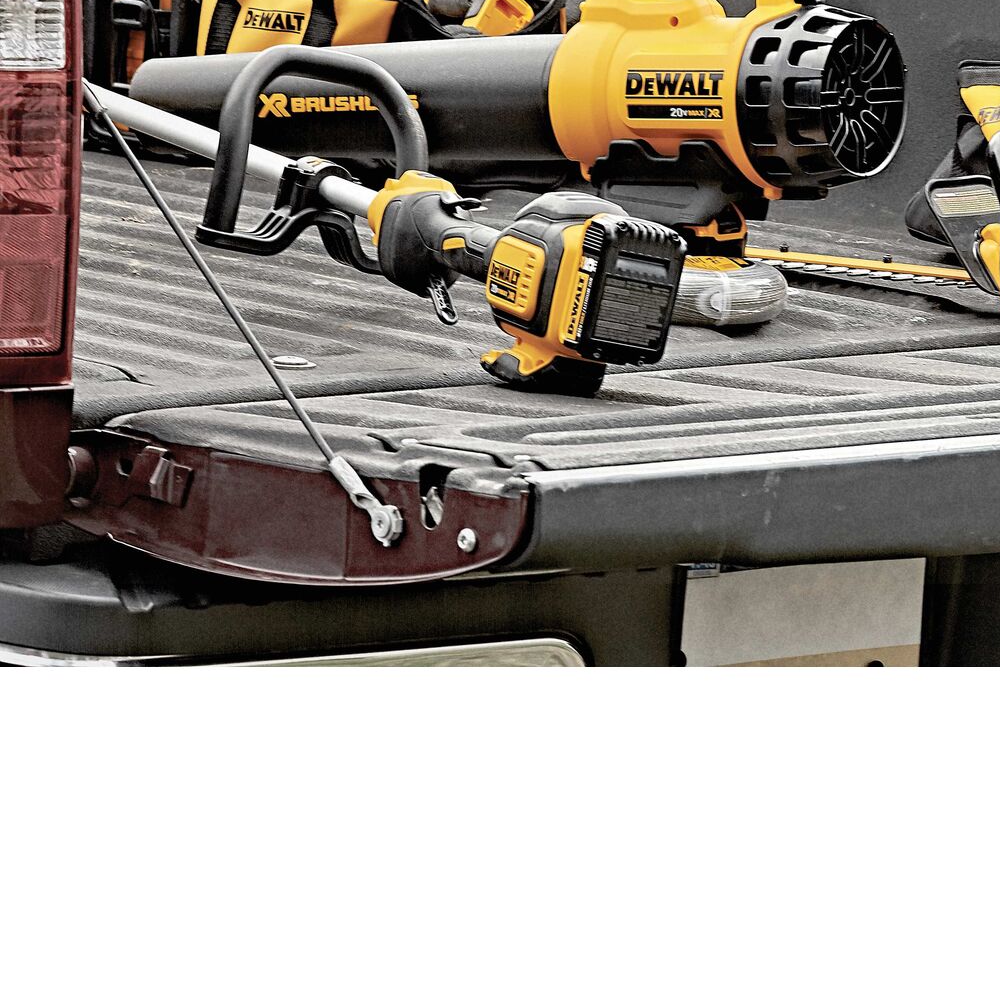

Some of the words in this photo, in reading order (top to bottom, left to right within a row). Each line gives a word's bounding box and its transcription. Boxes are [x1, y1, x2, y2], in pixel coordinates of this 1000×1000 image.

[244, 10, 305, 31] DEWALT
[625, 72, 724, 96] DEWALT
[258, 93, 291, 118] XR
[290, 95, 419, 113] BRUSHLS
[567, 276, 584, 335] DEWALT
